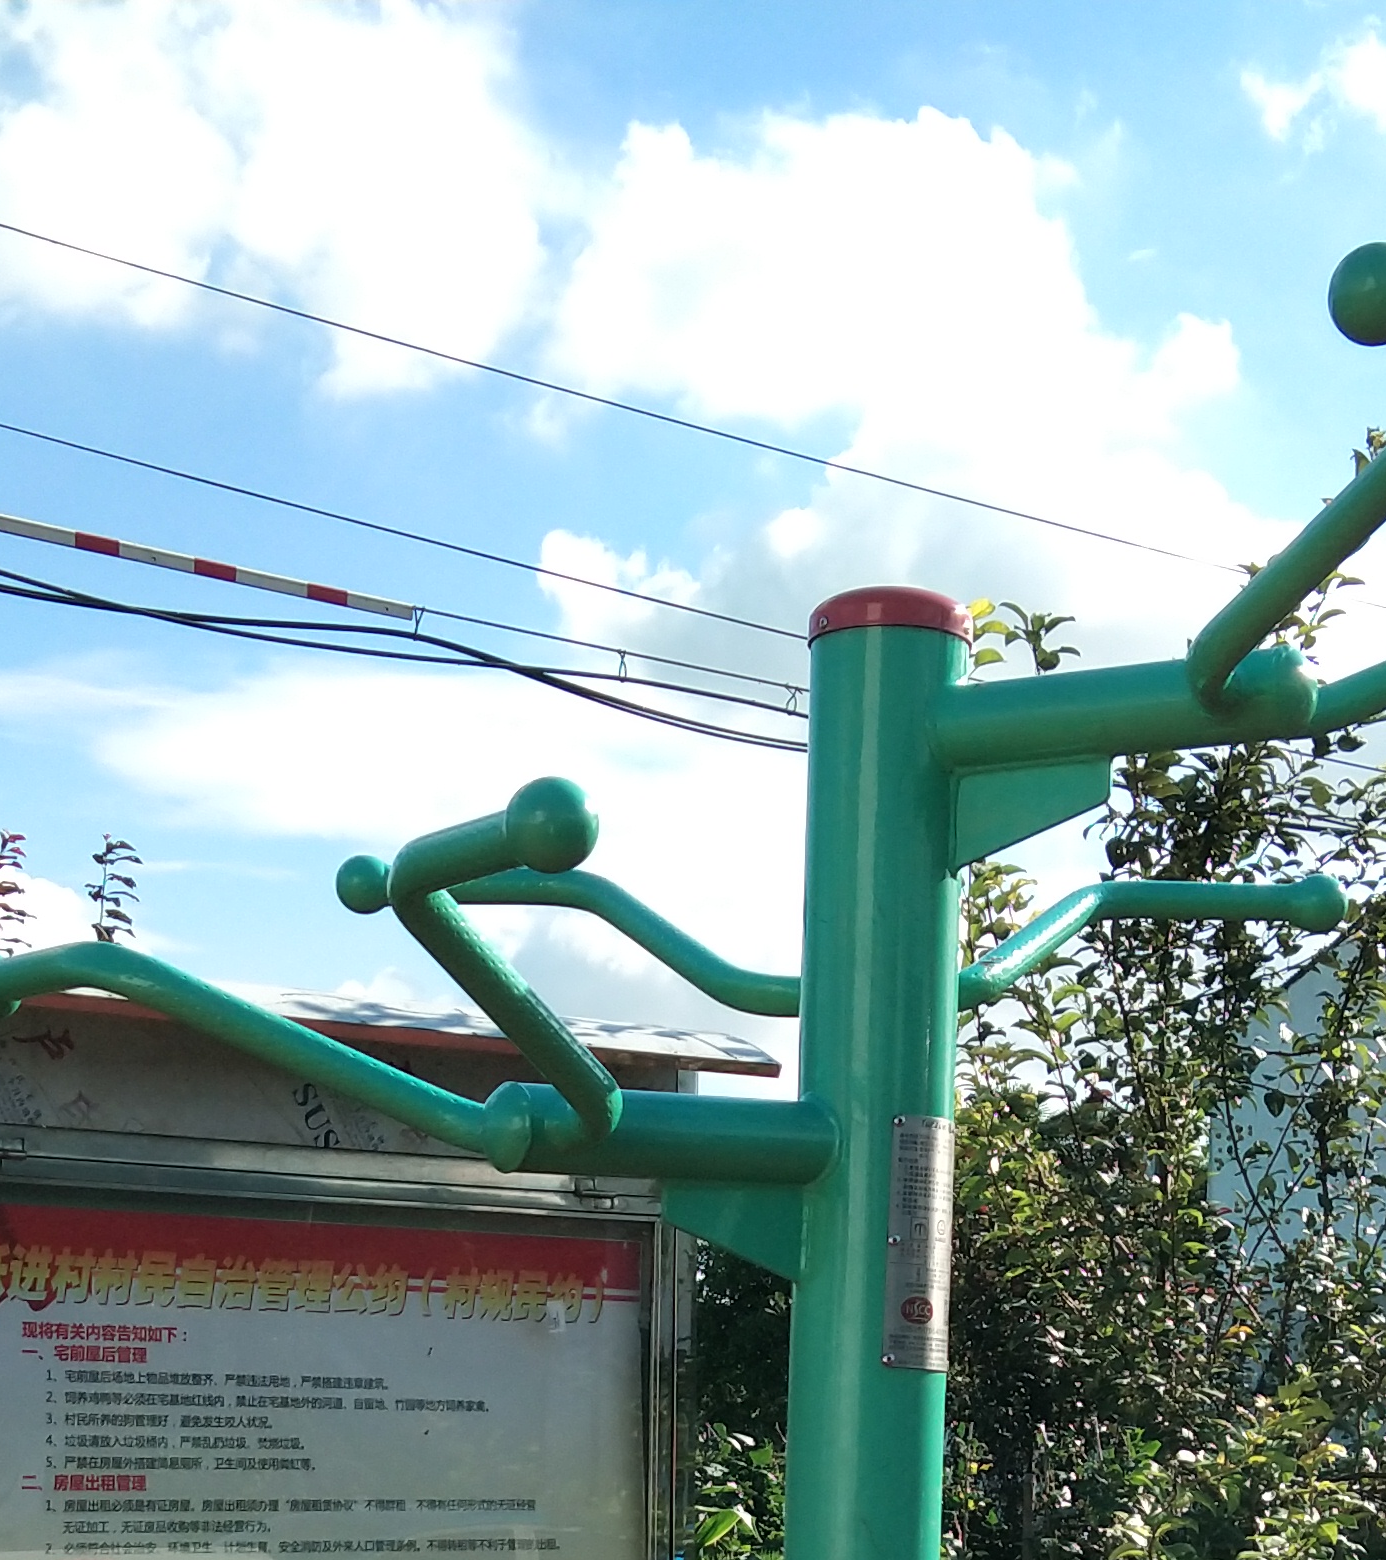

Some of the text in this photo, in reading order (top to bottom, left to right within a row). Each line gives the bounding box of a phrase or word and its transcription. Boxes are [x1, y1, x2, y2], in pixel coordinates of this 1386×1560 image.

[22, 1321, 188, 1343] 现将有关内容告知如下：
[22, 1345, 147, 1364] 一、宅前屋后管理
[21, 1474, 147, 1492] 二、房屋出租管理
